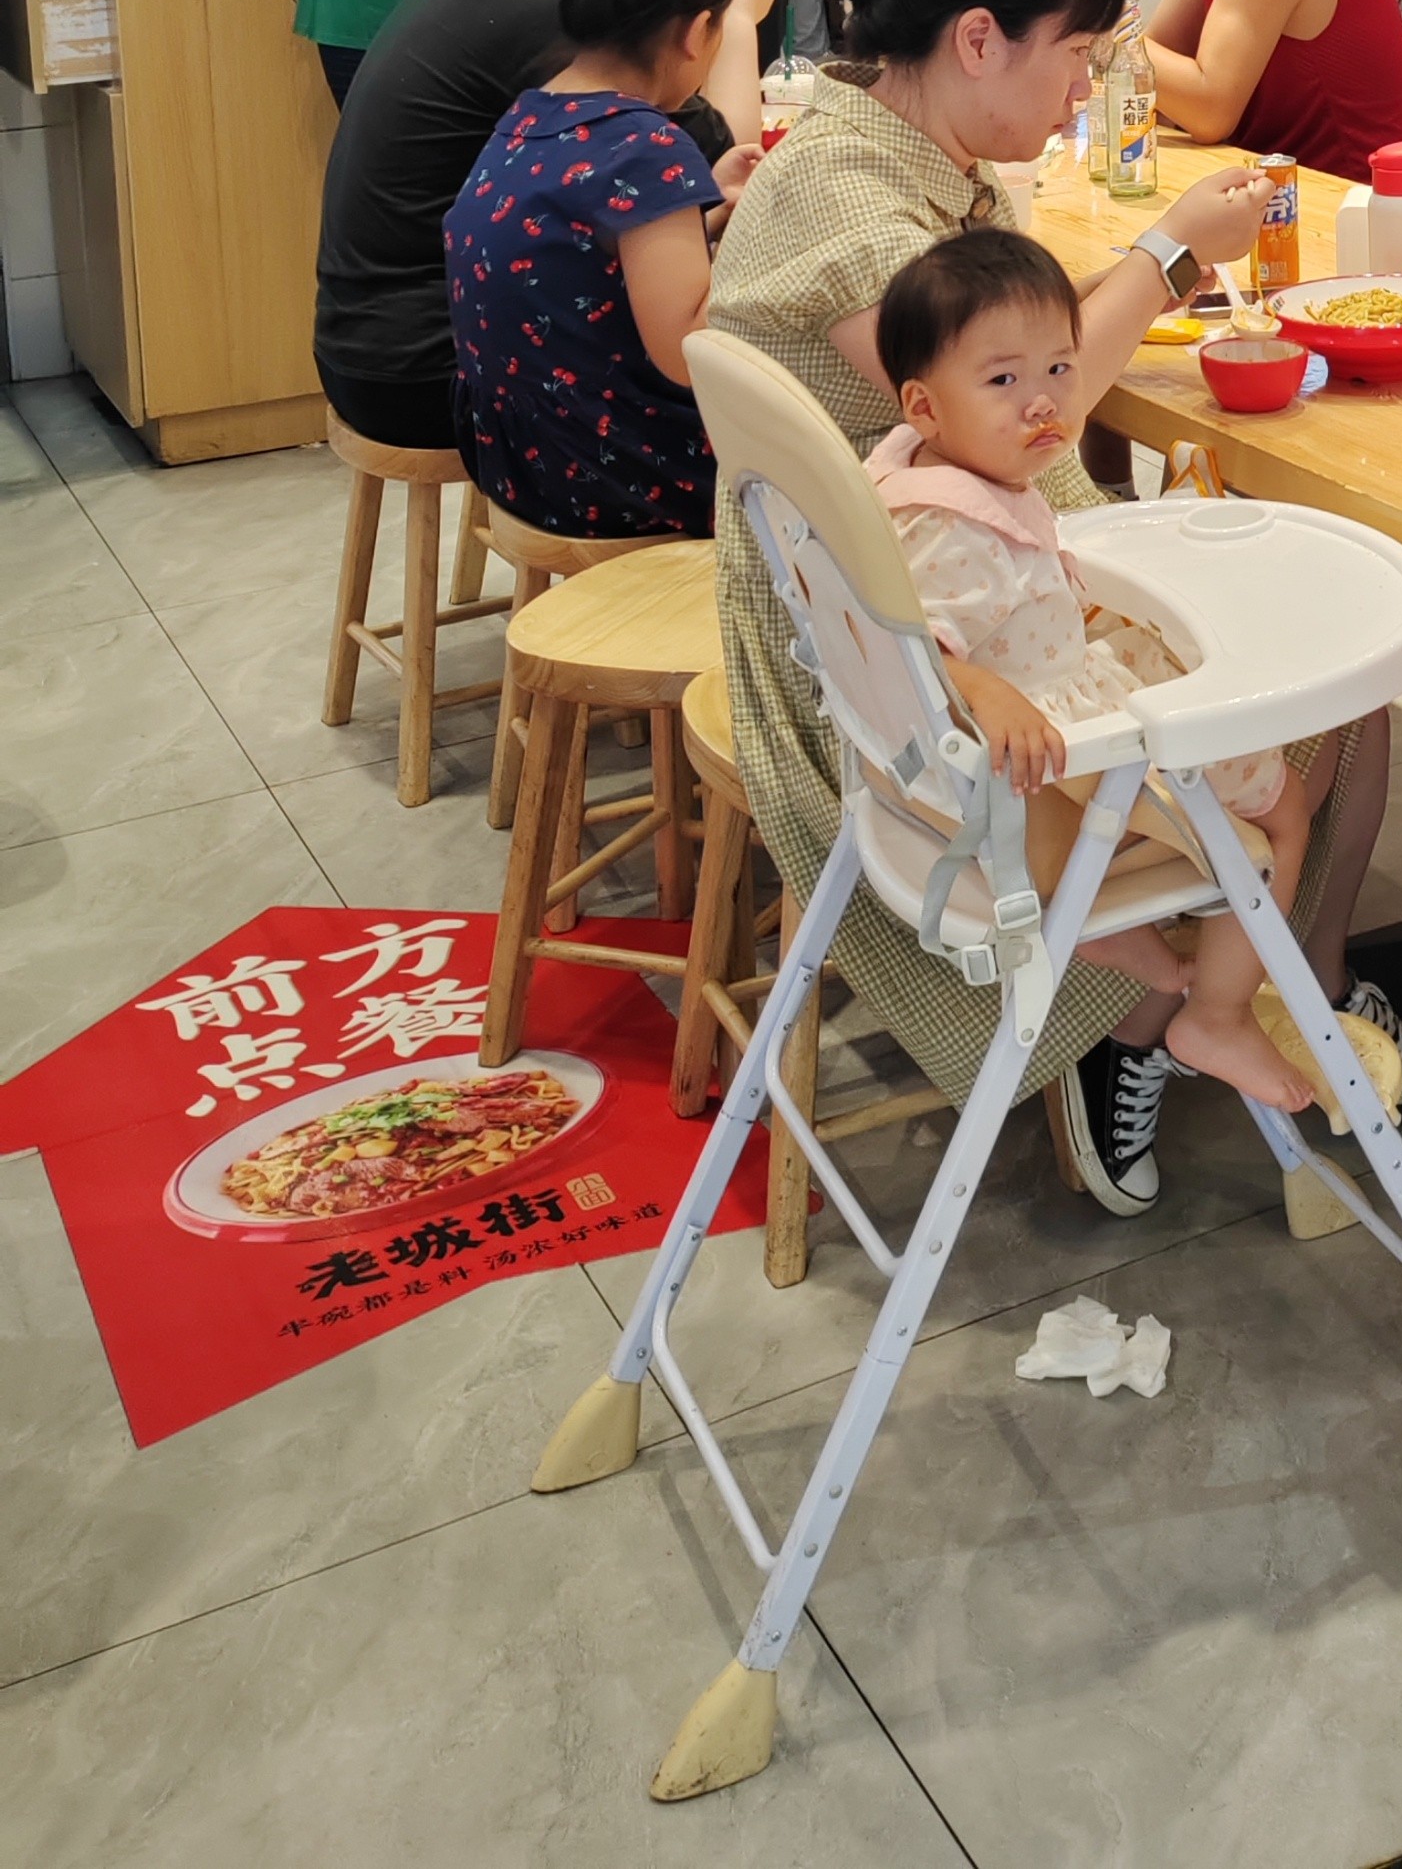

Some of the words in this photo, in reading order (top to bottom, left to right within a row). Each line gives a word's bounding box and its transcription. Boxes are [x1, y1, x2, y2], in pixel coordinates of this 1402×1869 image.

[135, 918, 468, 1040] 前方
[185, 978, 489, 1118] 点餐
[295, 1187, 566, 1302] 老城街
[484, 1201, 663, 1271] 汤浓好味道
